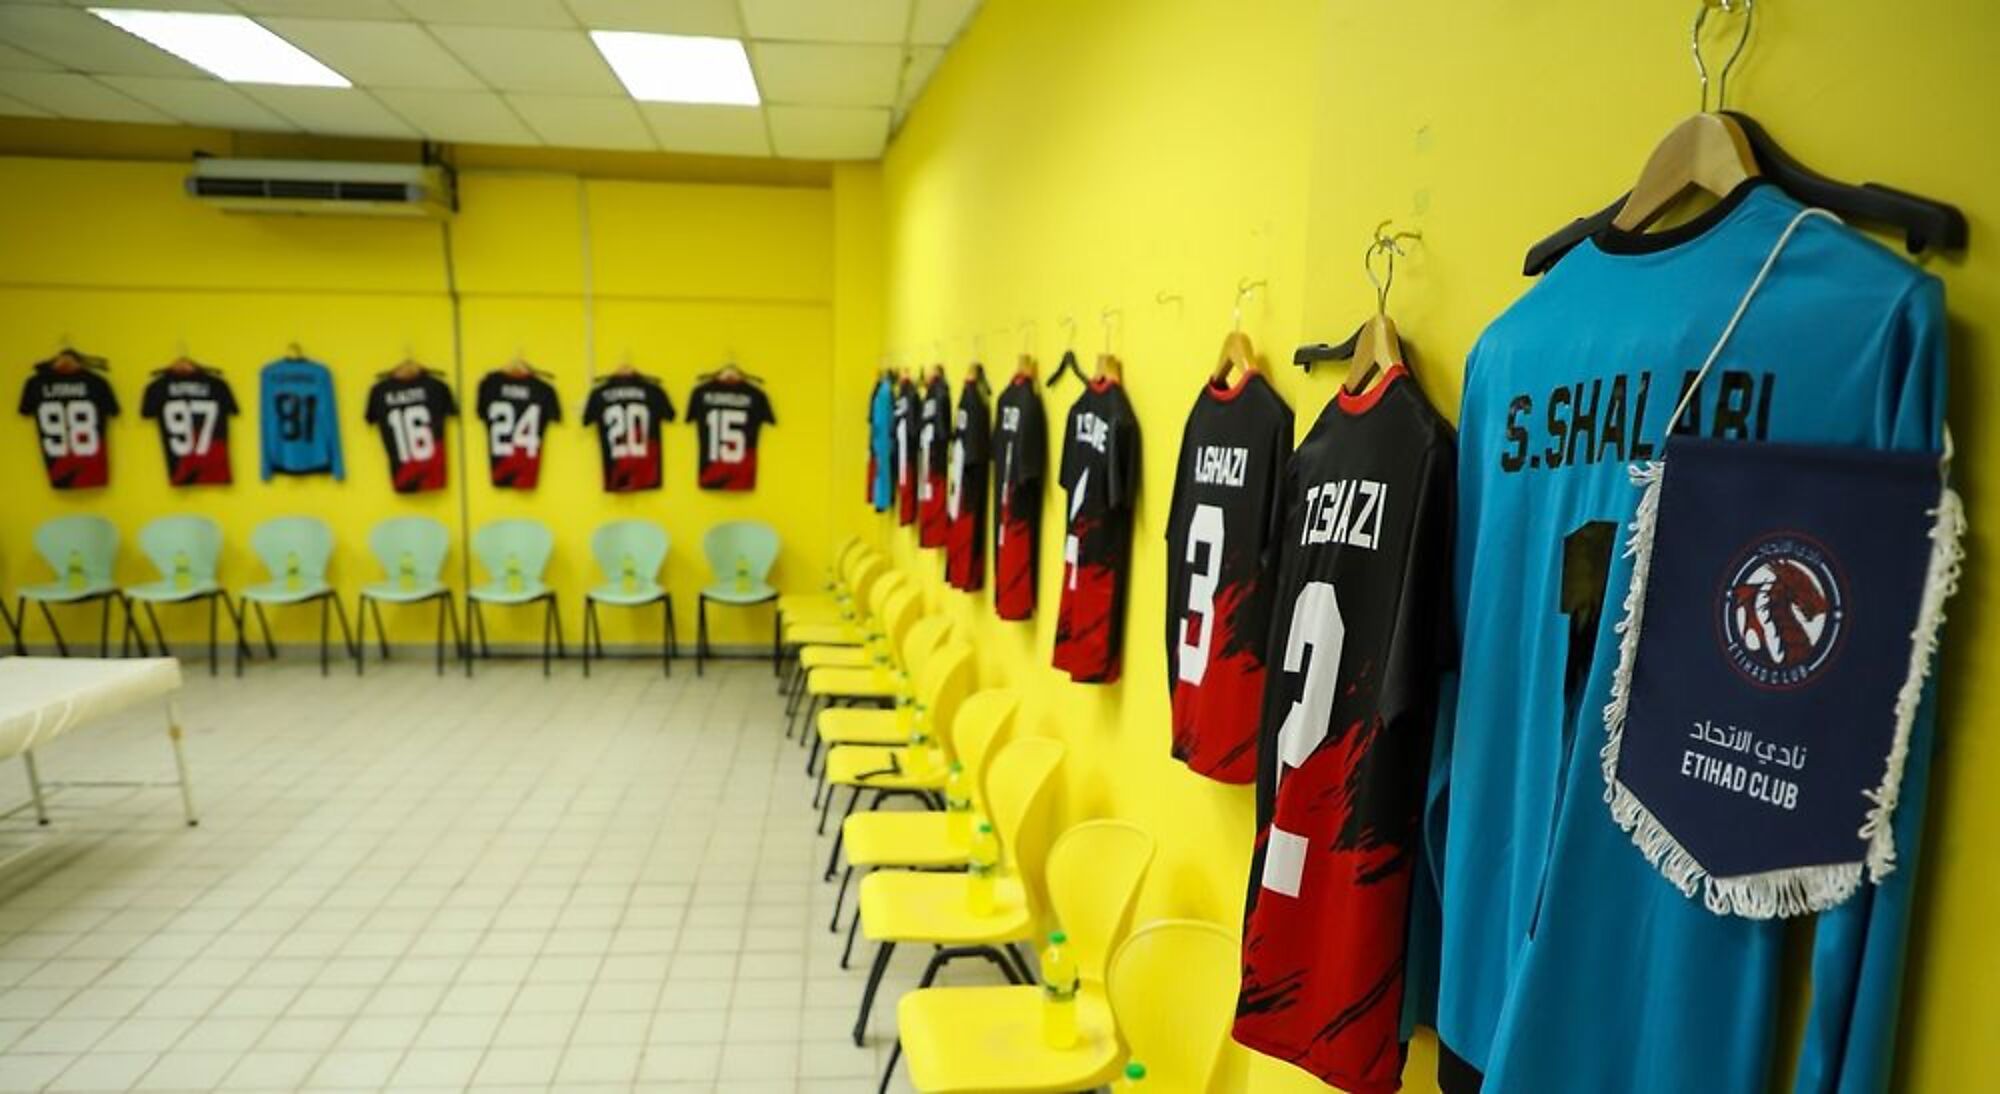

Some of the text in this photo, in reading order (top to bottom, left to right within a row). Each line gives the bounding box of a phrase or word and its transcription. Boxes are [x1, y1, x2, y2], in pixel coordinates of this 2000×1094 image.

[38, 401, 98, 456] 98
[163, 401, 219, 455] 97
[388, 405, 434, 463] 16
[488, 401, 540, 457] 24
[603, 403, 650, 458] 20
[706, 409, 747, 463] 15
[1178, 503, 1225, 687] 3
[1261, 581, 1345, 898] 2
[1689, 720, 1807, 770] نادي الاتحاد
[1681, 750, 1799, 810] ETIHAD CLUB
